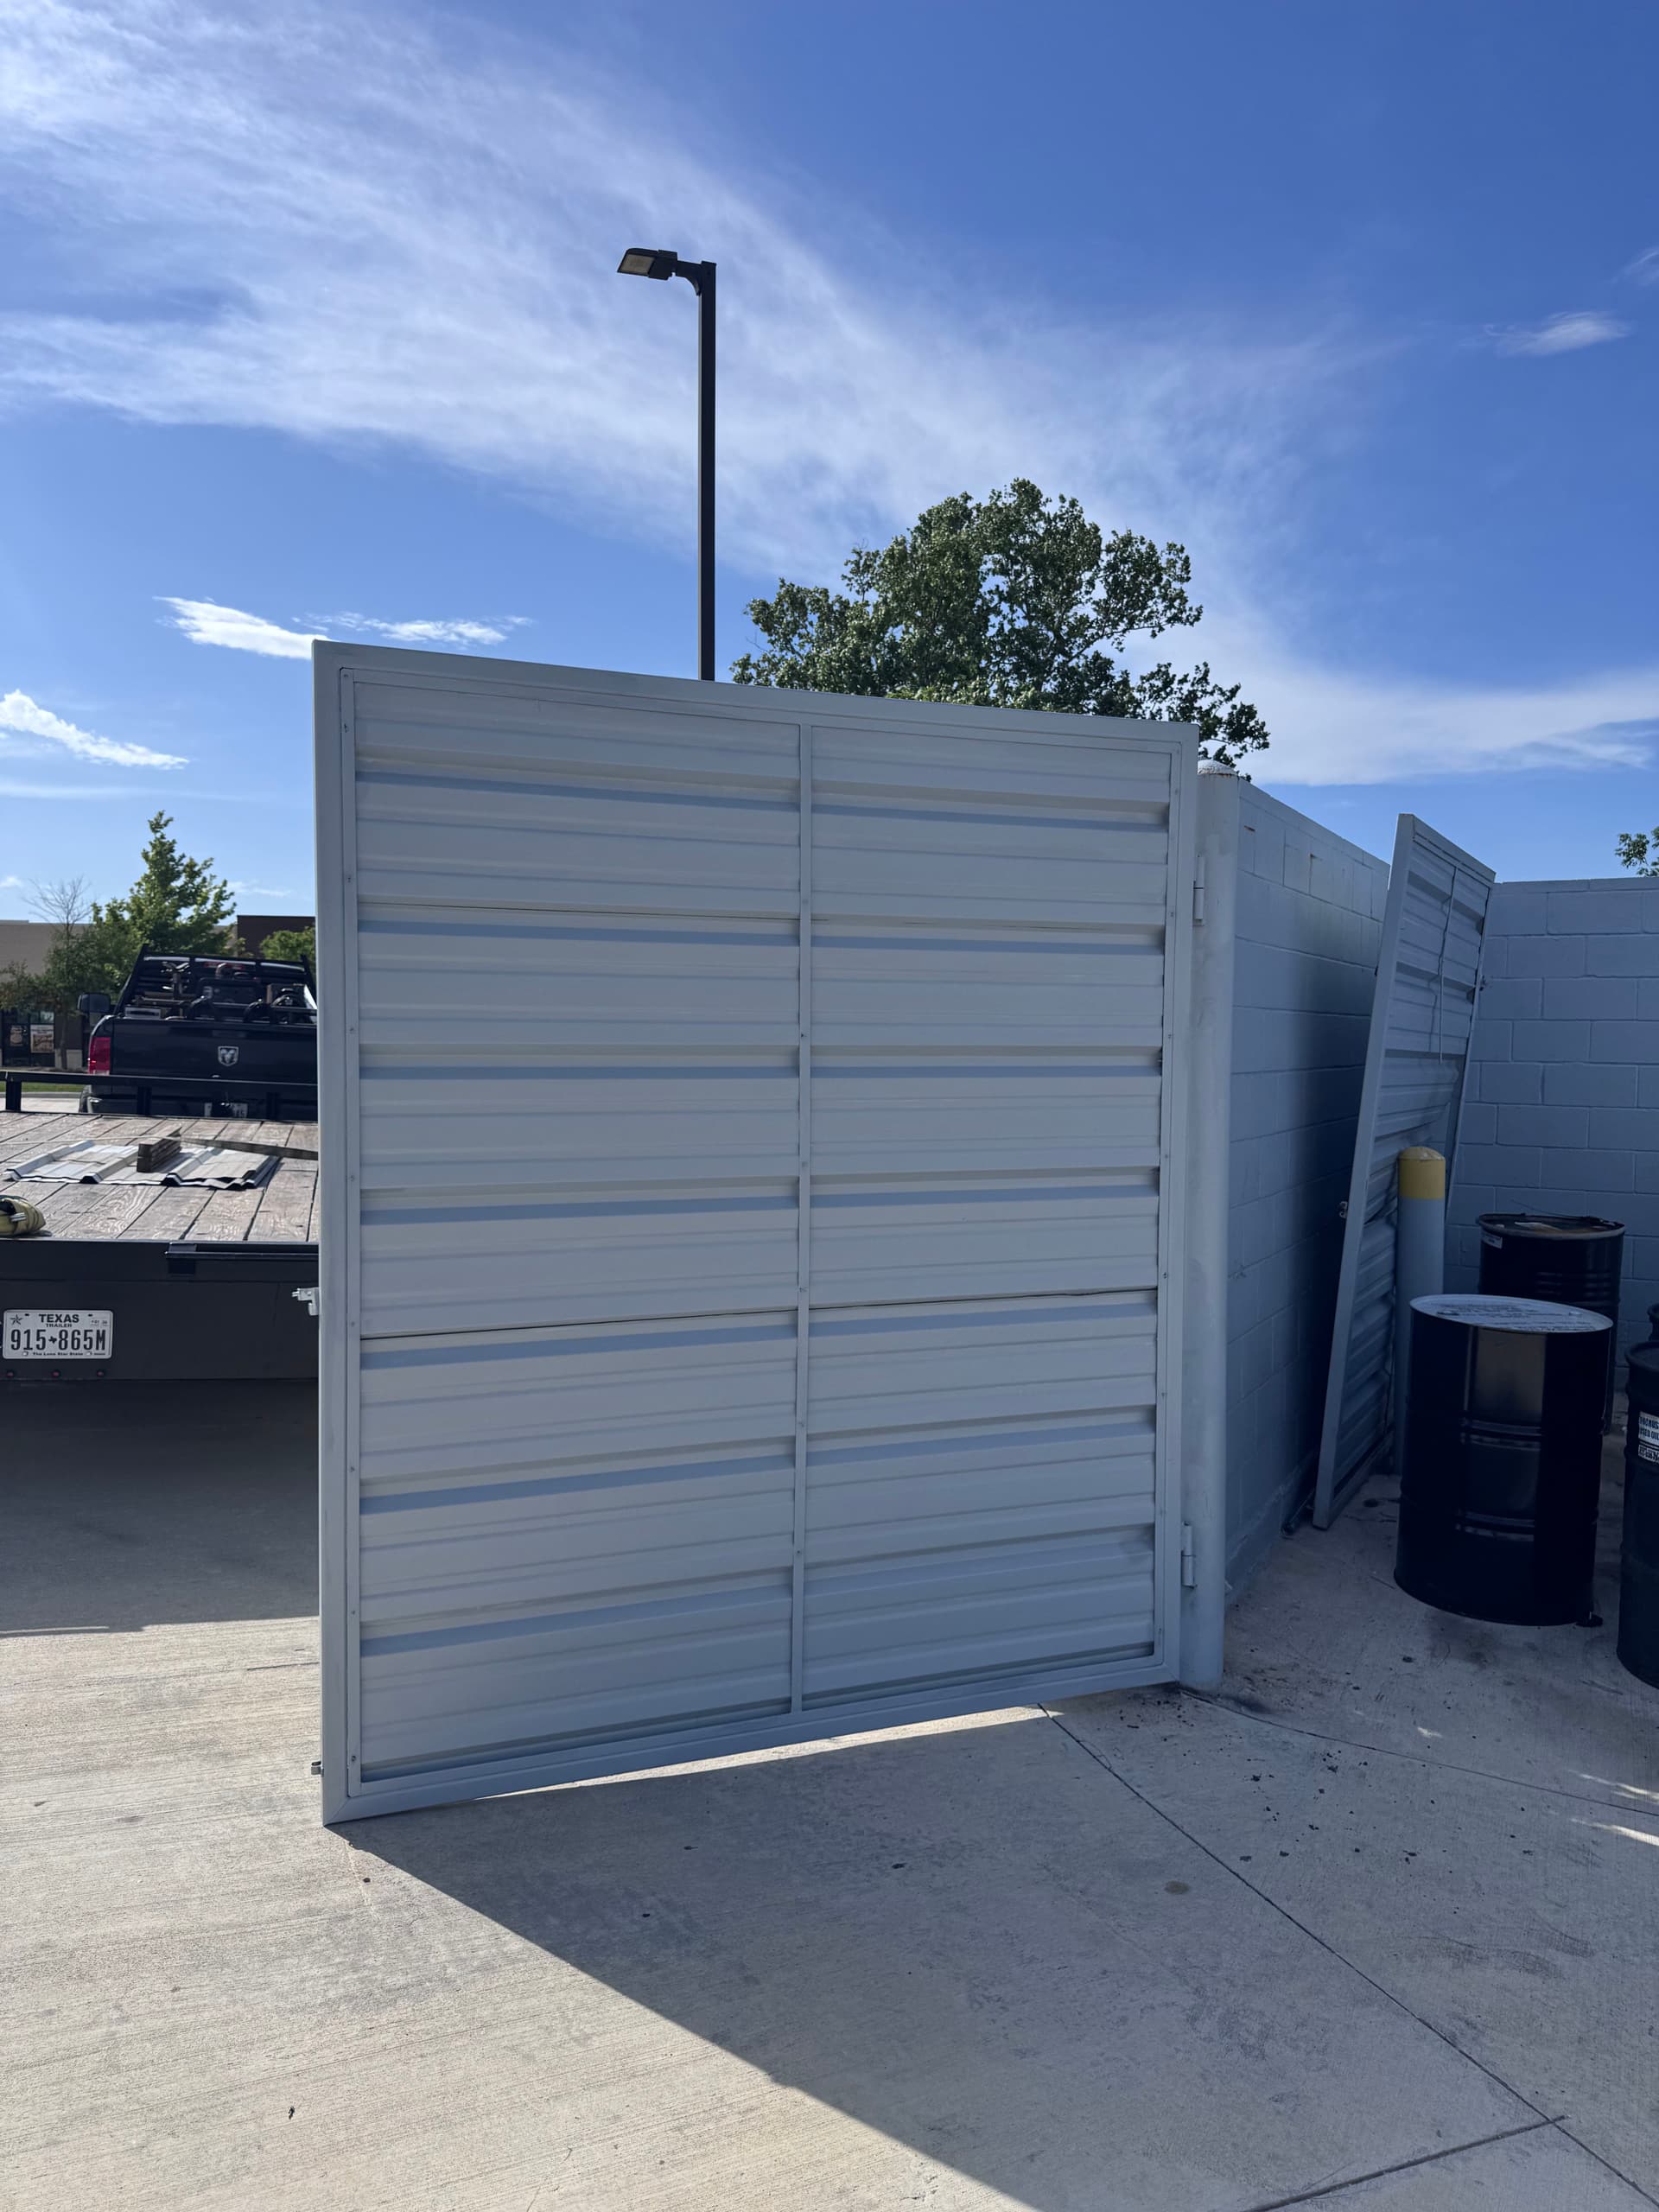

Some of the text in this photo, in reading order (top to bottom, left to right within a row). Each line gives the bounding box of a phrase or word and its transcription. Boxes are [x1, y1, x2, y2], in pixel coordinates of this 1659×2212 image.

[38, 1313, 79, 1323] TEXAS
[10, 1329, 105, 1351] 915 865M
